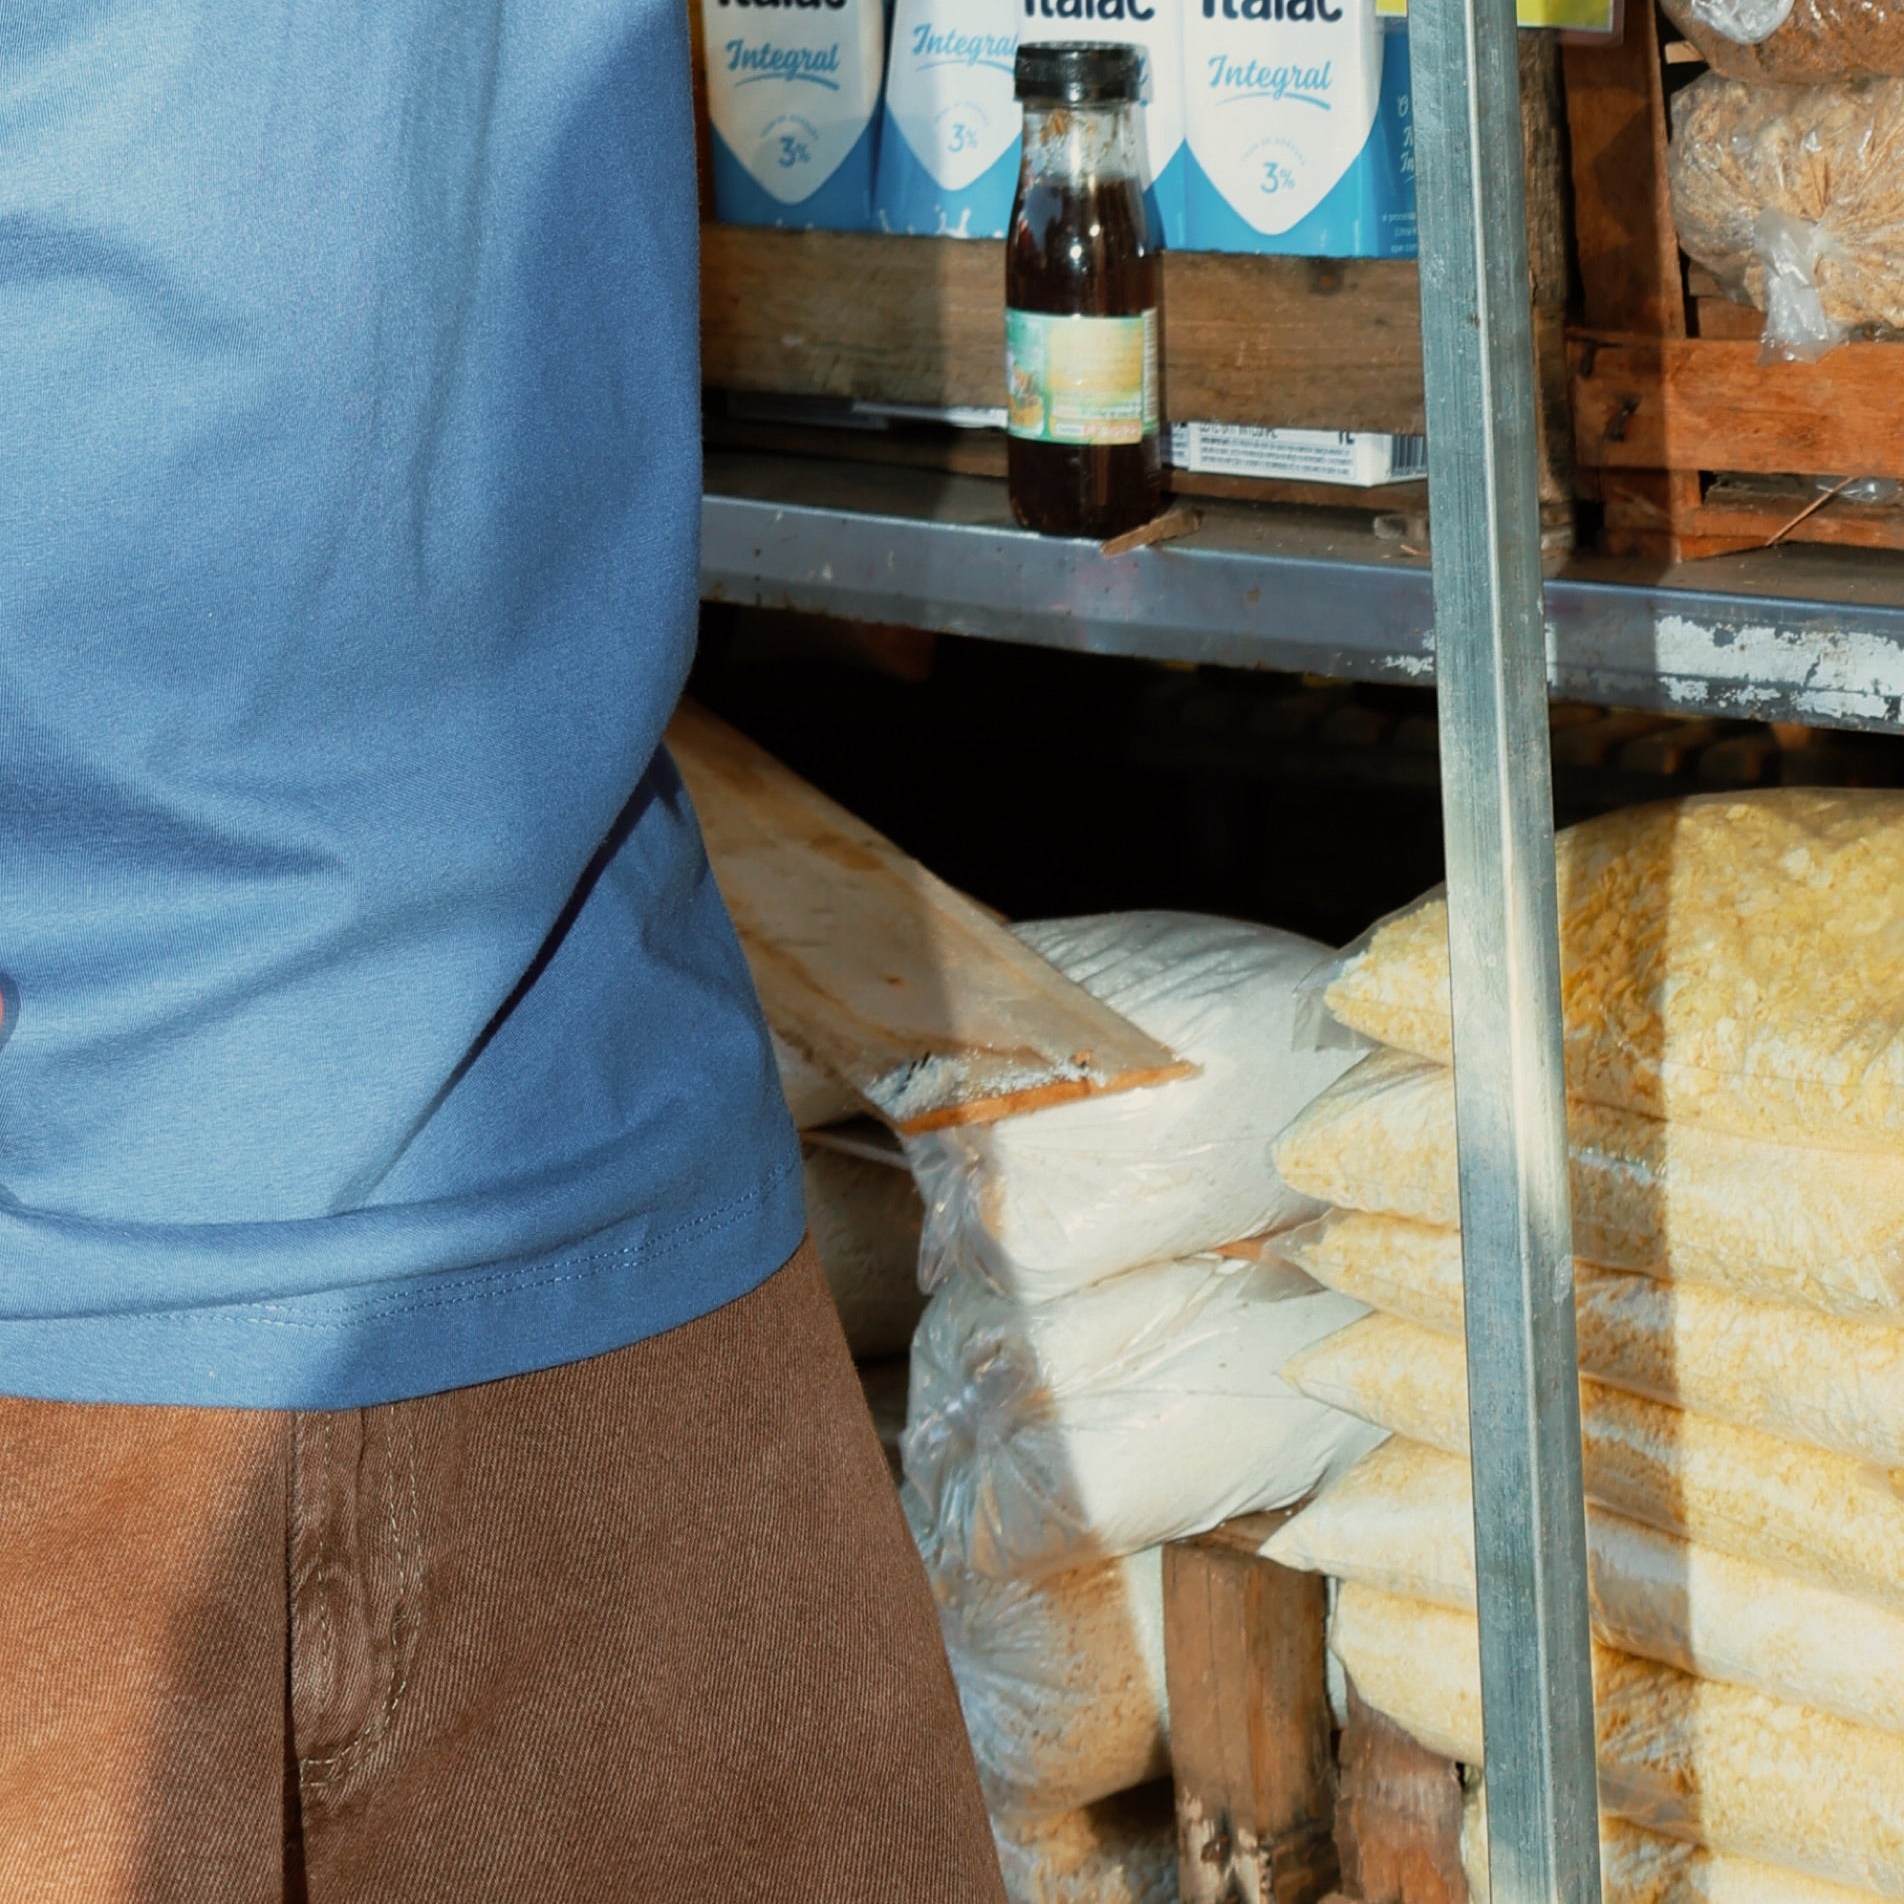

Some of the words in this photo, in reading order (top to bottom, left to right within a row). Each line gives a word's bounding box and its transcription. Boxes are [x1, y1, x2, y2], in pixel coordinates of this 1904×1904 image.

[725, 39, 841, 81] Integral
[912, 22, 1019, 66] Integral
[1207, 54, 1332, 101] Integral
[777, 135, 811, 169] 3%
[1259, 161, 1296, 194] 3%
